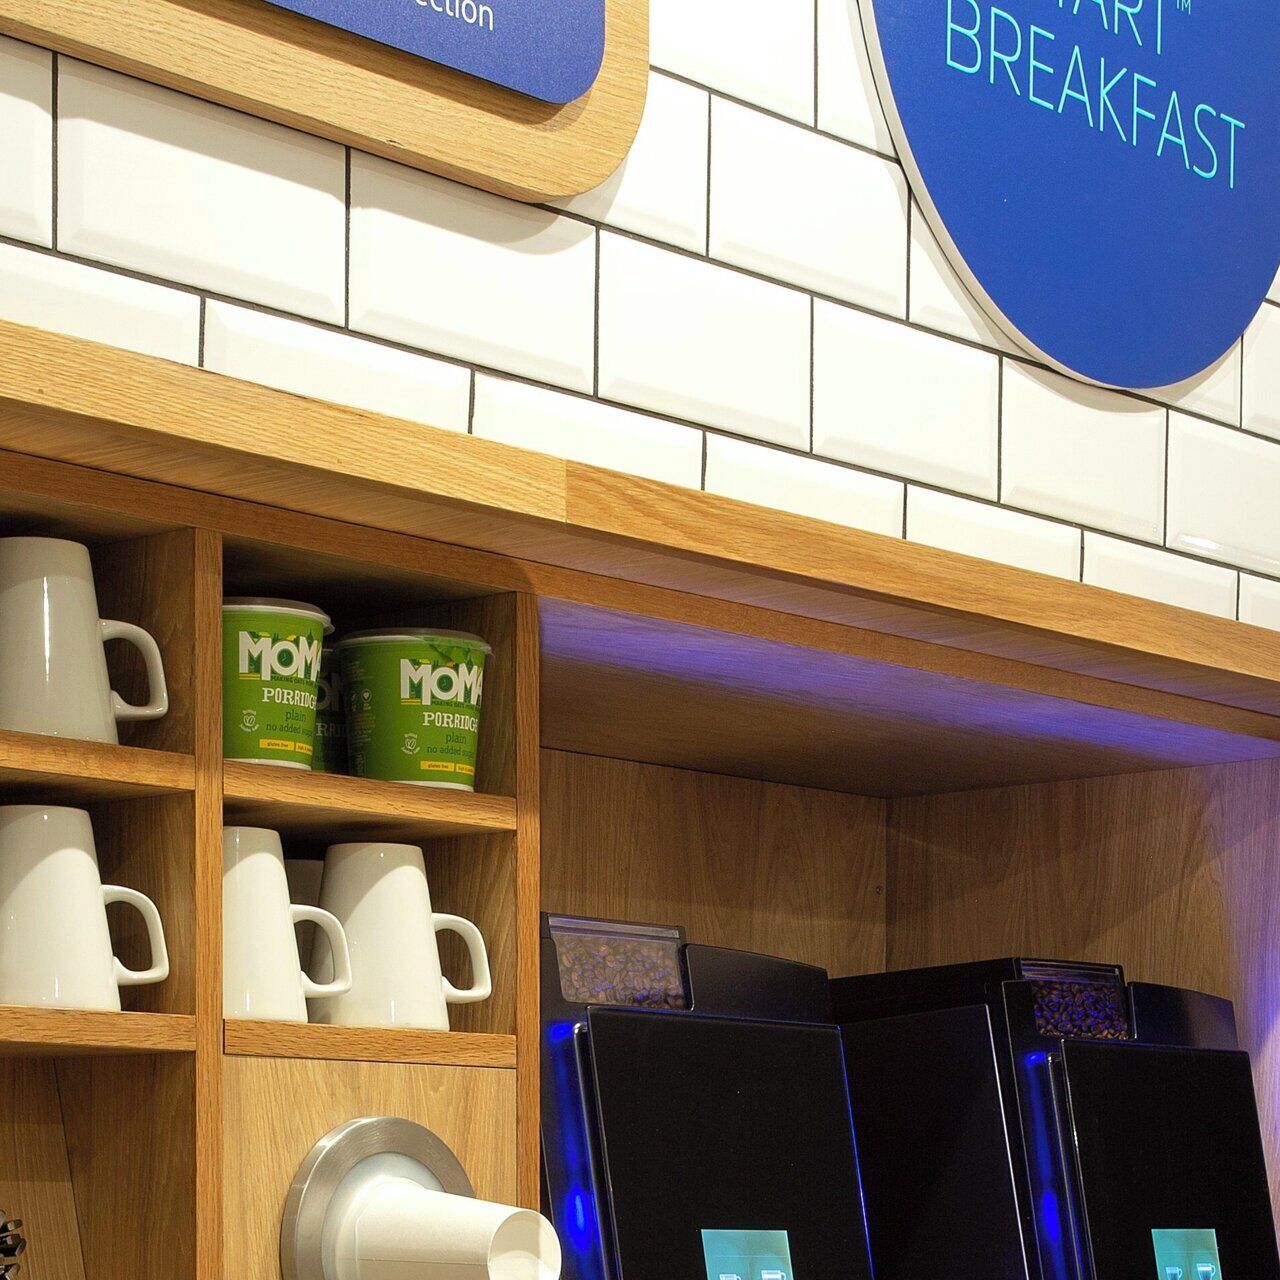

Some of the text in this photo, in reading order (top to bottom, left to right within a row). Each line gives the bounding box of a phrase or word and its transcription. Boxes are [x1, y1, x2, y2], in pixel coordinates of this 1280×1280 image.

[946, 0, 1245, 188] BREAKFAST
[286, 709, 306, 722] plain
[279, 723, 301, 734] added
[446, 732, 466, 744] plain
[427, 745, 461, 756] no added
